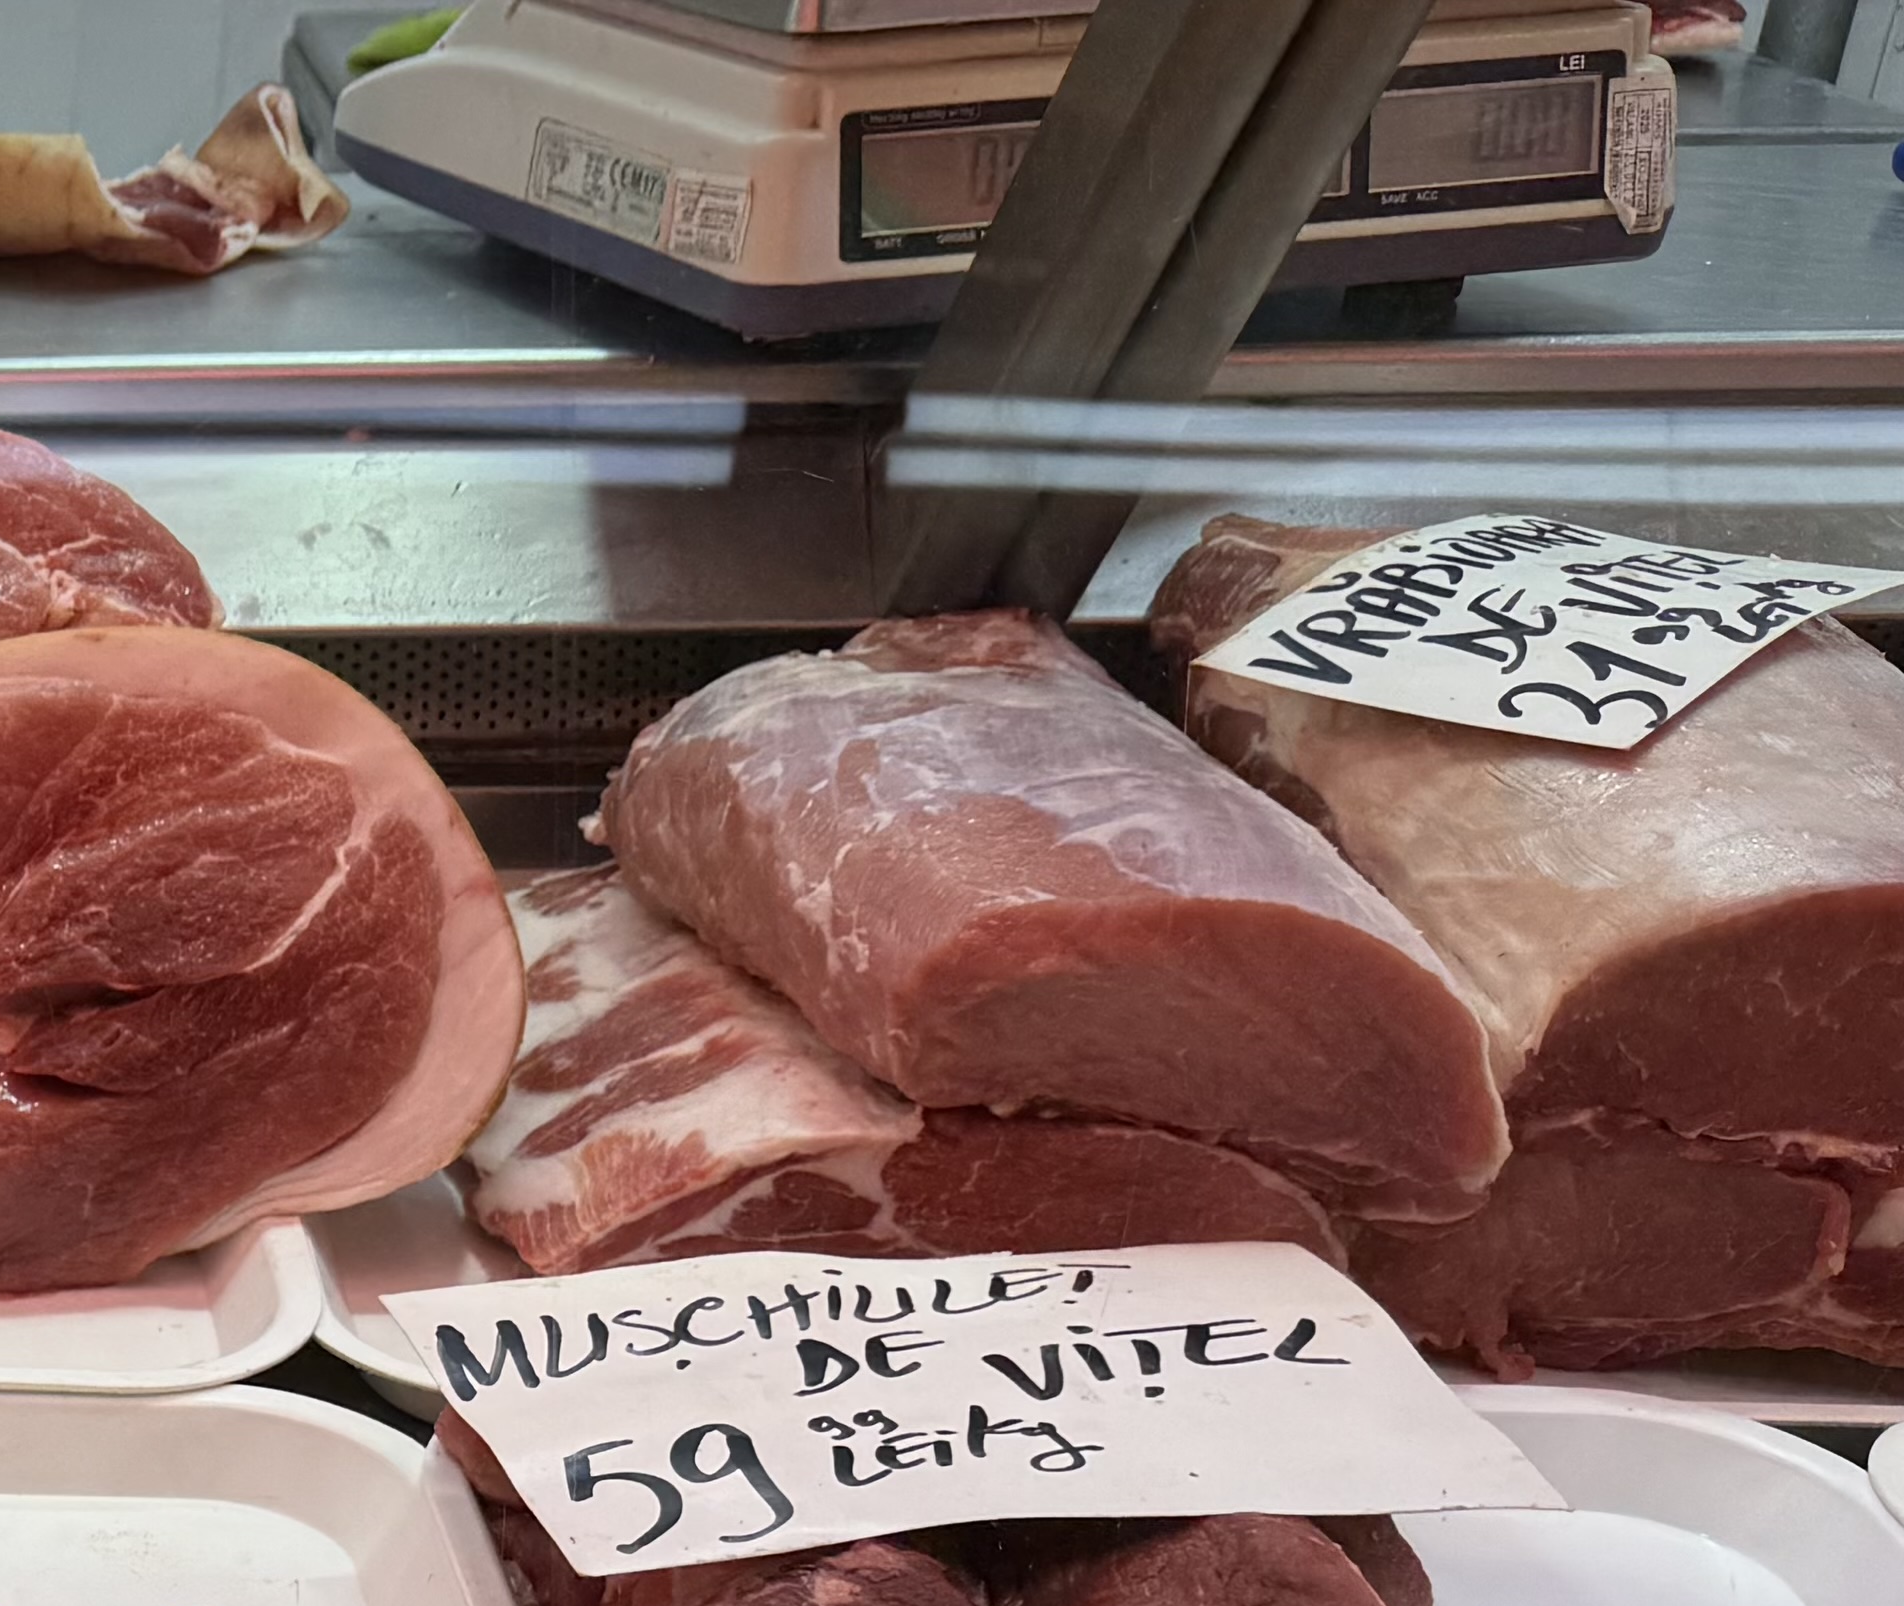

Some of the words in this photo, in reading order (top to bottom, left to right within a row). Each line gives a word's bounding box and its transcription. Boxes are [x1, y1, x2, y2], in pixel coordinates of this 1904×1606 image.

[1559, 54, 1585, 72] LEI
[1418, 583, 1558, 675] DE
[1496, 641, 1687, 729] 31
[1632, 606, 1723, 645] 99
[792, 1330, 945, 1397] DE
[807, 1408, 899, 1441] 99
[563, 1423, 794, 1555] 59
[832, 1430, 959, 1488] LEI
